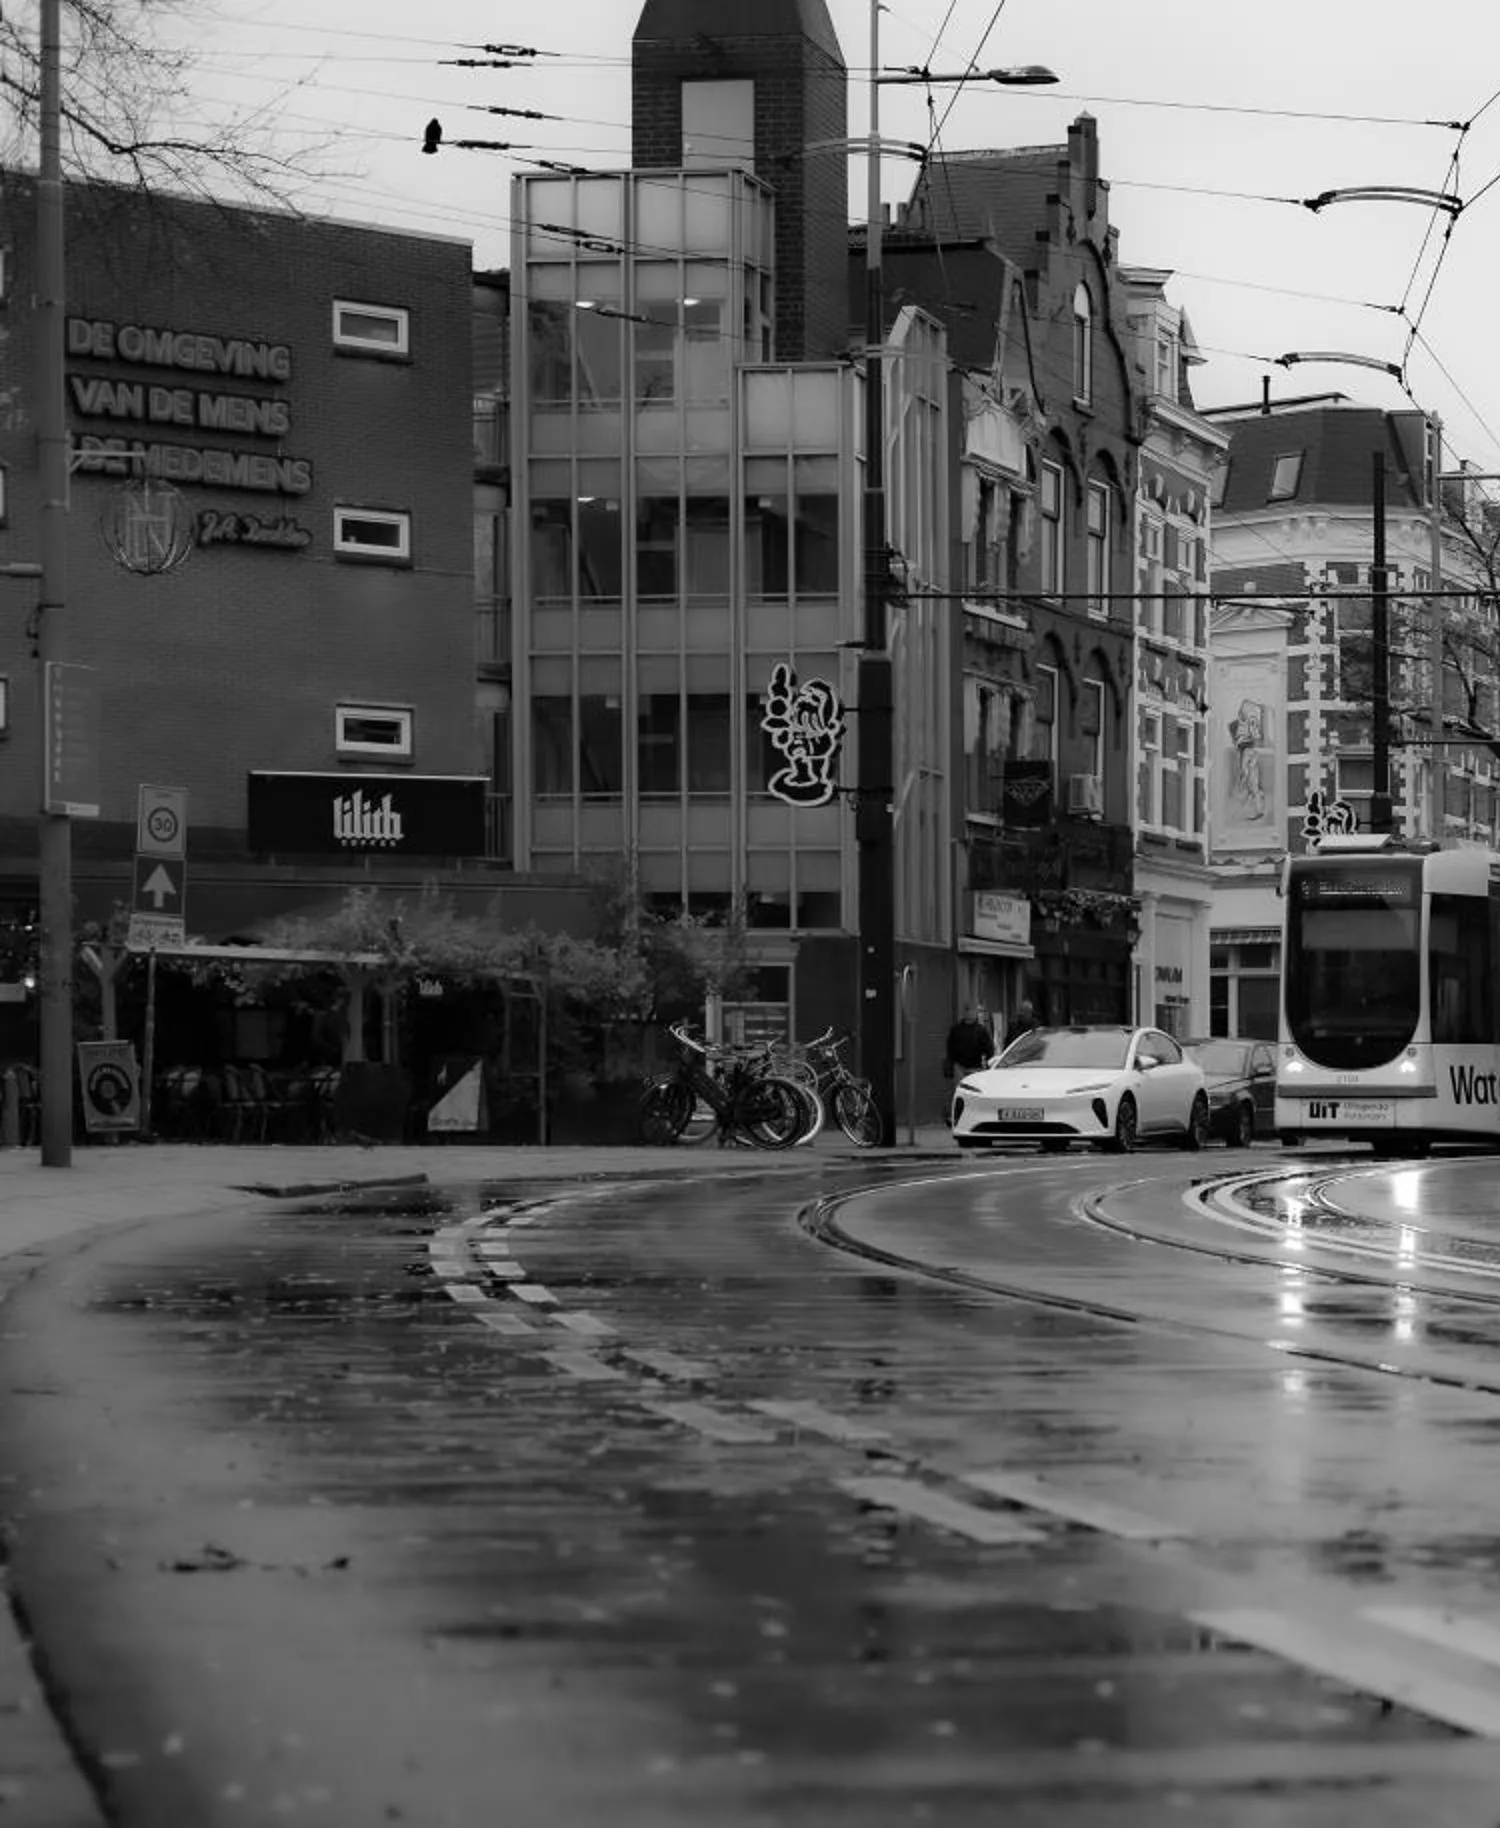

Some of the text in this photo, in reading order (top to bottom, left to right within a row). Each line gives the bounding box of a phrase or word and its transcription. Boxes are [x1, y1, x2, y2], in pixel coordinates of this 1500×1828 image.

[67, 318, 291, 380] DE OMGEVING
[70, 376, 290, 436] VAN DE MENS
[81, 435, 312, 494] DE MEDEMENS
[154, 816, 173, 833] 30
[332, 788, 405, 841] lilith
[1449, 1065, 1498, 1105] Wat
